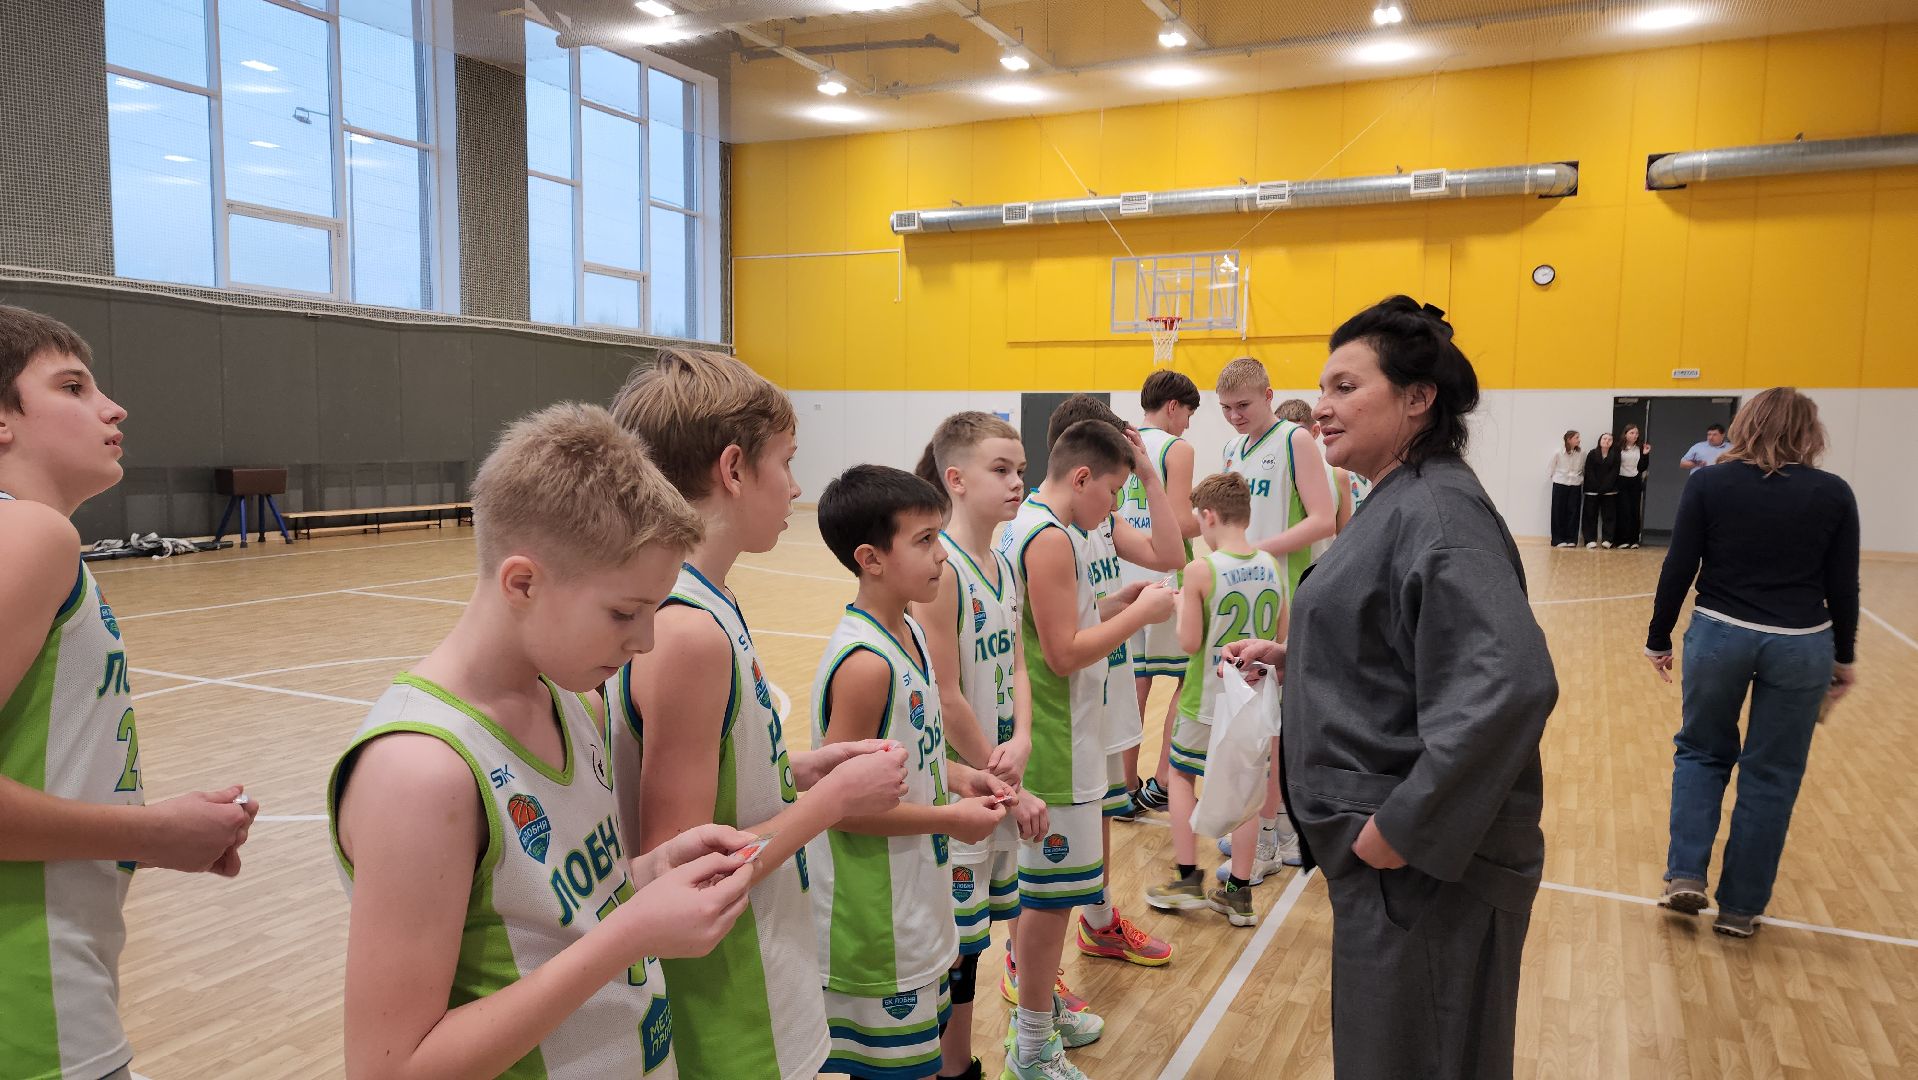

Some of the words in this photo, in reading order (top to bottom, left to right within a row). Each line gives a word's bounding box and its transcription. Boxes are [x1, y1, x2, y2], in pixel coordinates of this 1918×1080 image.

[1214, 588, 1280, 648] 20
[549, 812, 626, 929] ЛОБН
[895, 996, 916, 1004] ЛОБНЯ
